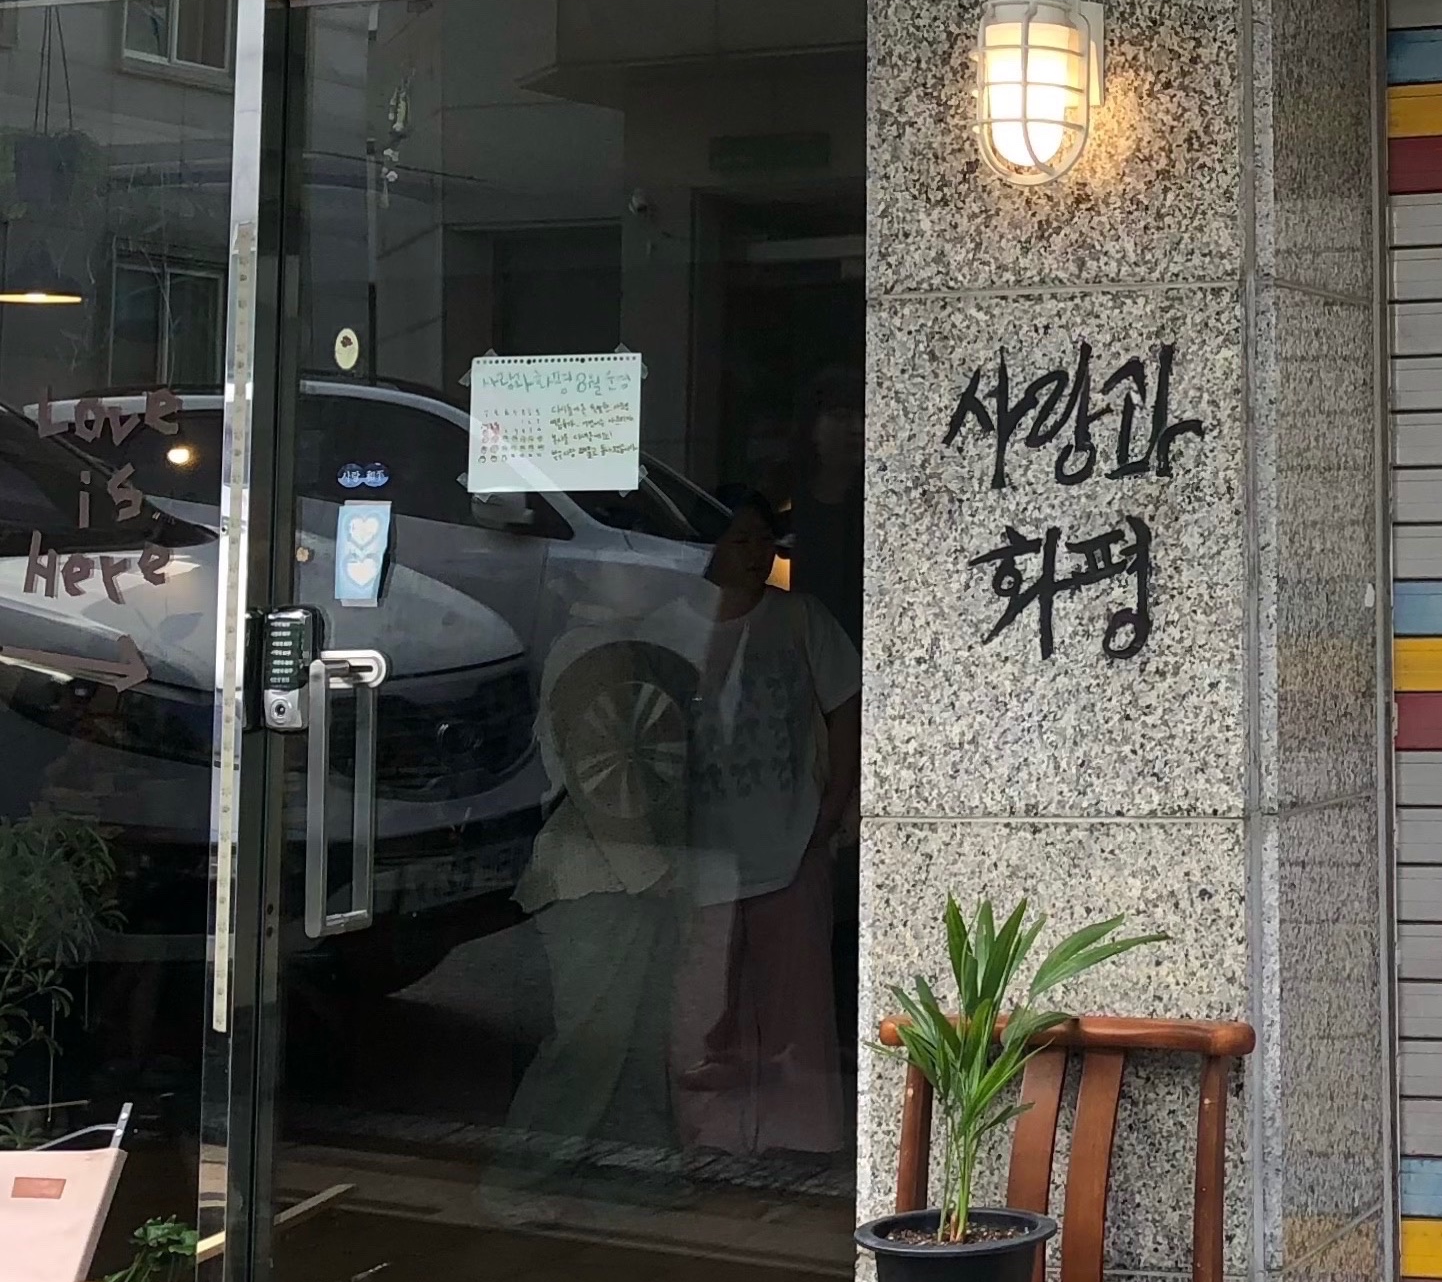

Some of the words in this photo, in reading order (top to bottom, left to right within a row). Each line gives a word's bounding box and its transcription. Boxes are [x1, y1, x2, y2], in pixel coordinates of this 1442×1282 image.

[38, 385, 184, 447] Love
[942, 339, 1205, 489] 사랑과
[79, 462, 142, 529] is
[23, 529, 173, 605] Here
[968, 515, 1152, 660] 화평
